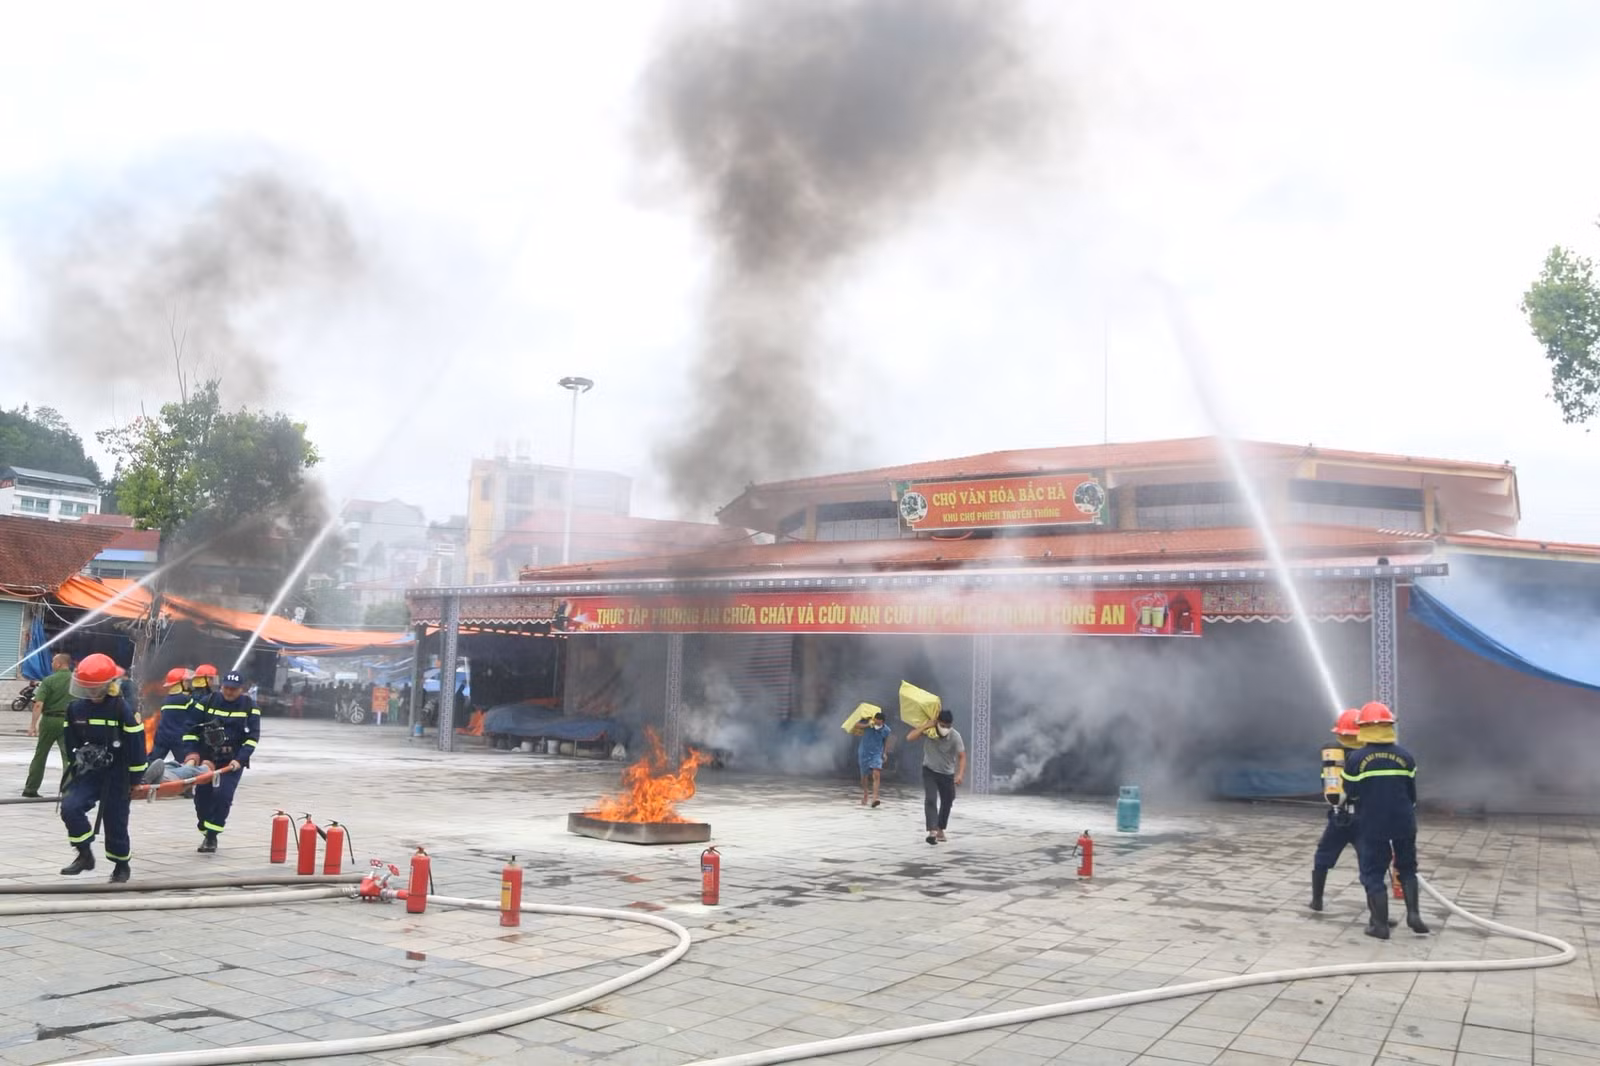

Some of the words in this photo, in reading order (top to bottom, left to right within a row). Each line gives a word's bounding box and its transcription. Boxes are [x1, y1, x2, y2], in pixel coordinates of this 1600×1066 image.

[932, 490, 957, 509] CHỢ
[960, 487, 986, 504] VĂN
[989, 485, 1016, 503] HÓA
[1018, 481, 1044, 501] BẮC
[1047, 482, 1067, 500] HÀ
[943, 513, 958, 522] KHU
[960, 511, 976, 523] CHỢ
[977, 509, 1001, 521] PHIÊN
[628, 605, 648, 628] TẬP
[723, 602, 756, 625] CHỮA
[760, 602, 794, 625] CHÁY
[797, 602, 814, 625] VÀ
[818, 602, 846, 625] CỨU
[850, 605, 880, 628] NẠN
[1101, 604, 1125, 625] AN
